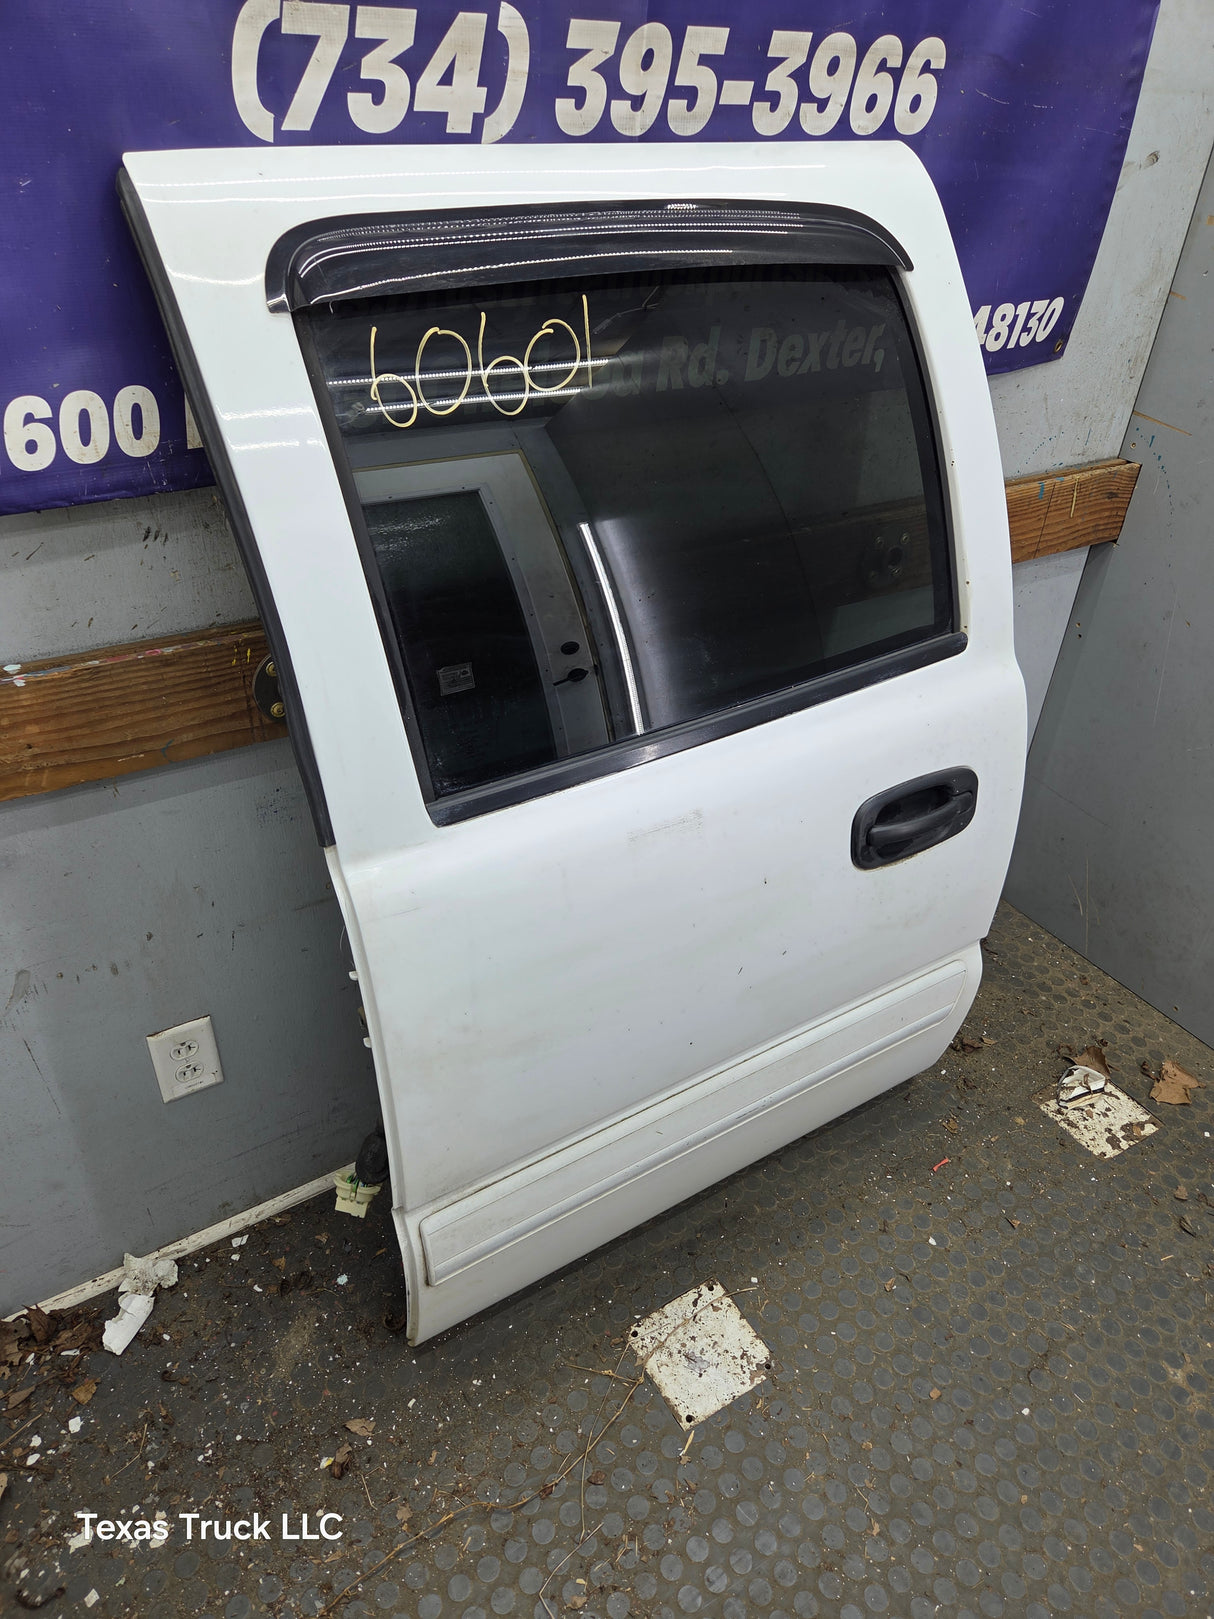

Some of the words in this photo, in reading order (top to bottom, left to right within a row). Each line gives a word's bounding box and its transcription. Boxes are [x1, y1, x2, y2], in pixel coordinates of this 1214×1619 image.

[231, 0, 530, 144] (734)
[555, 18, 947, 137] 395-3966
[3, 384, 161, 472] 600
[655, 325, 731, 393] Rd.
[744, 320, 888, 383] Dexter,
[973, 296, 1065, 353] 48130
[370, 294, 593, 428] 60601
